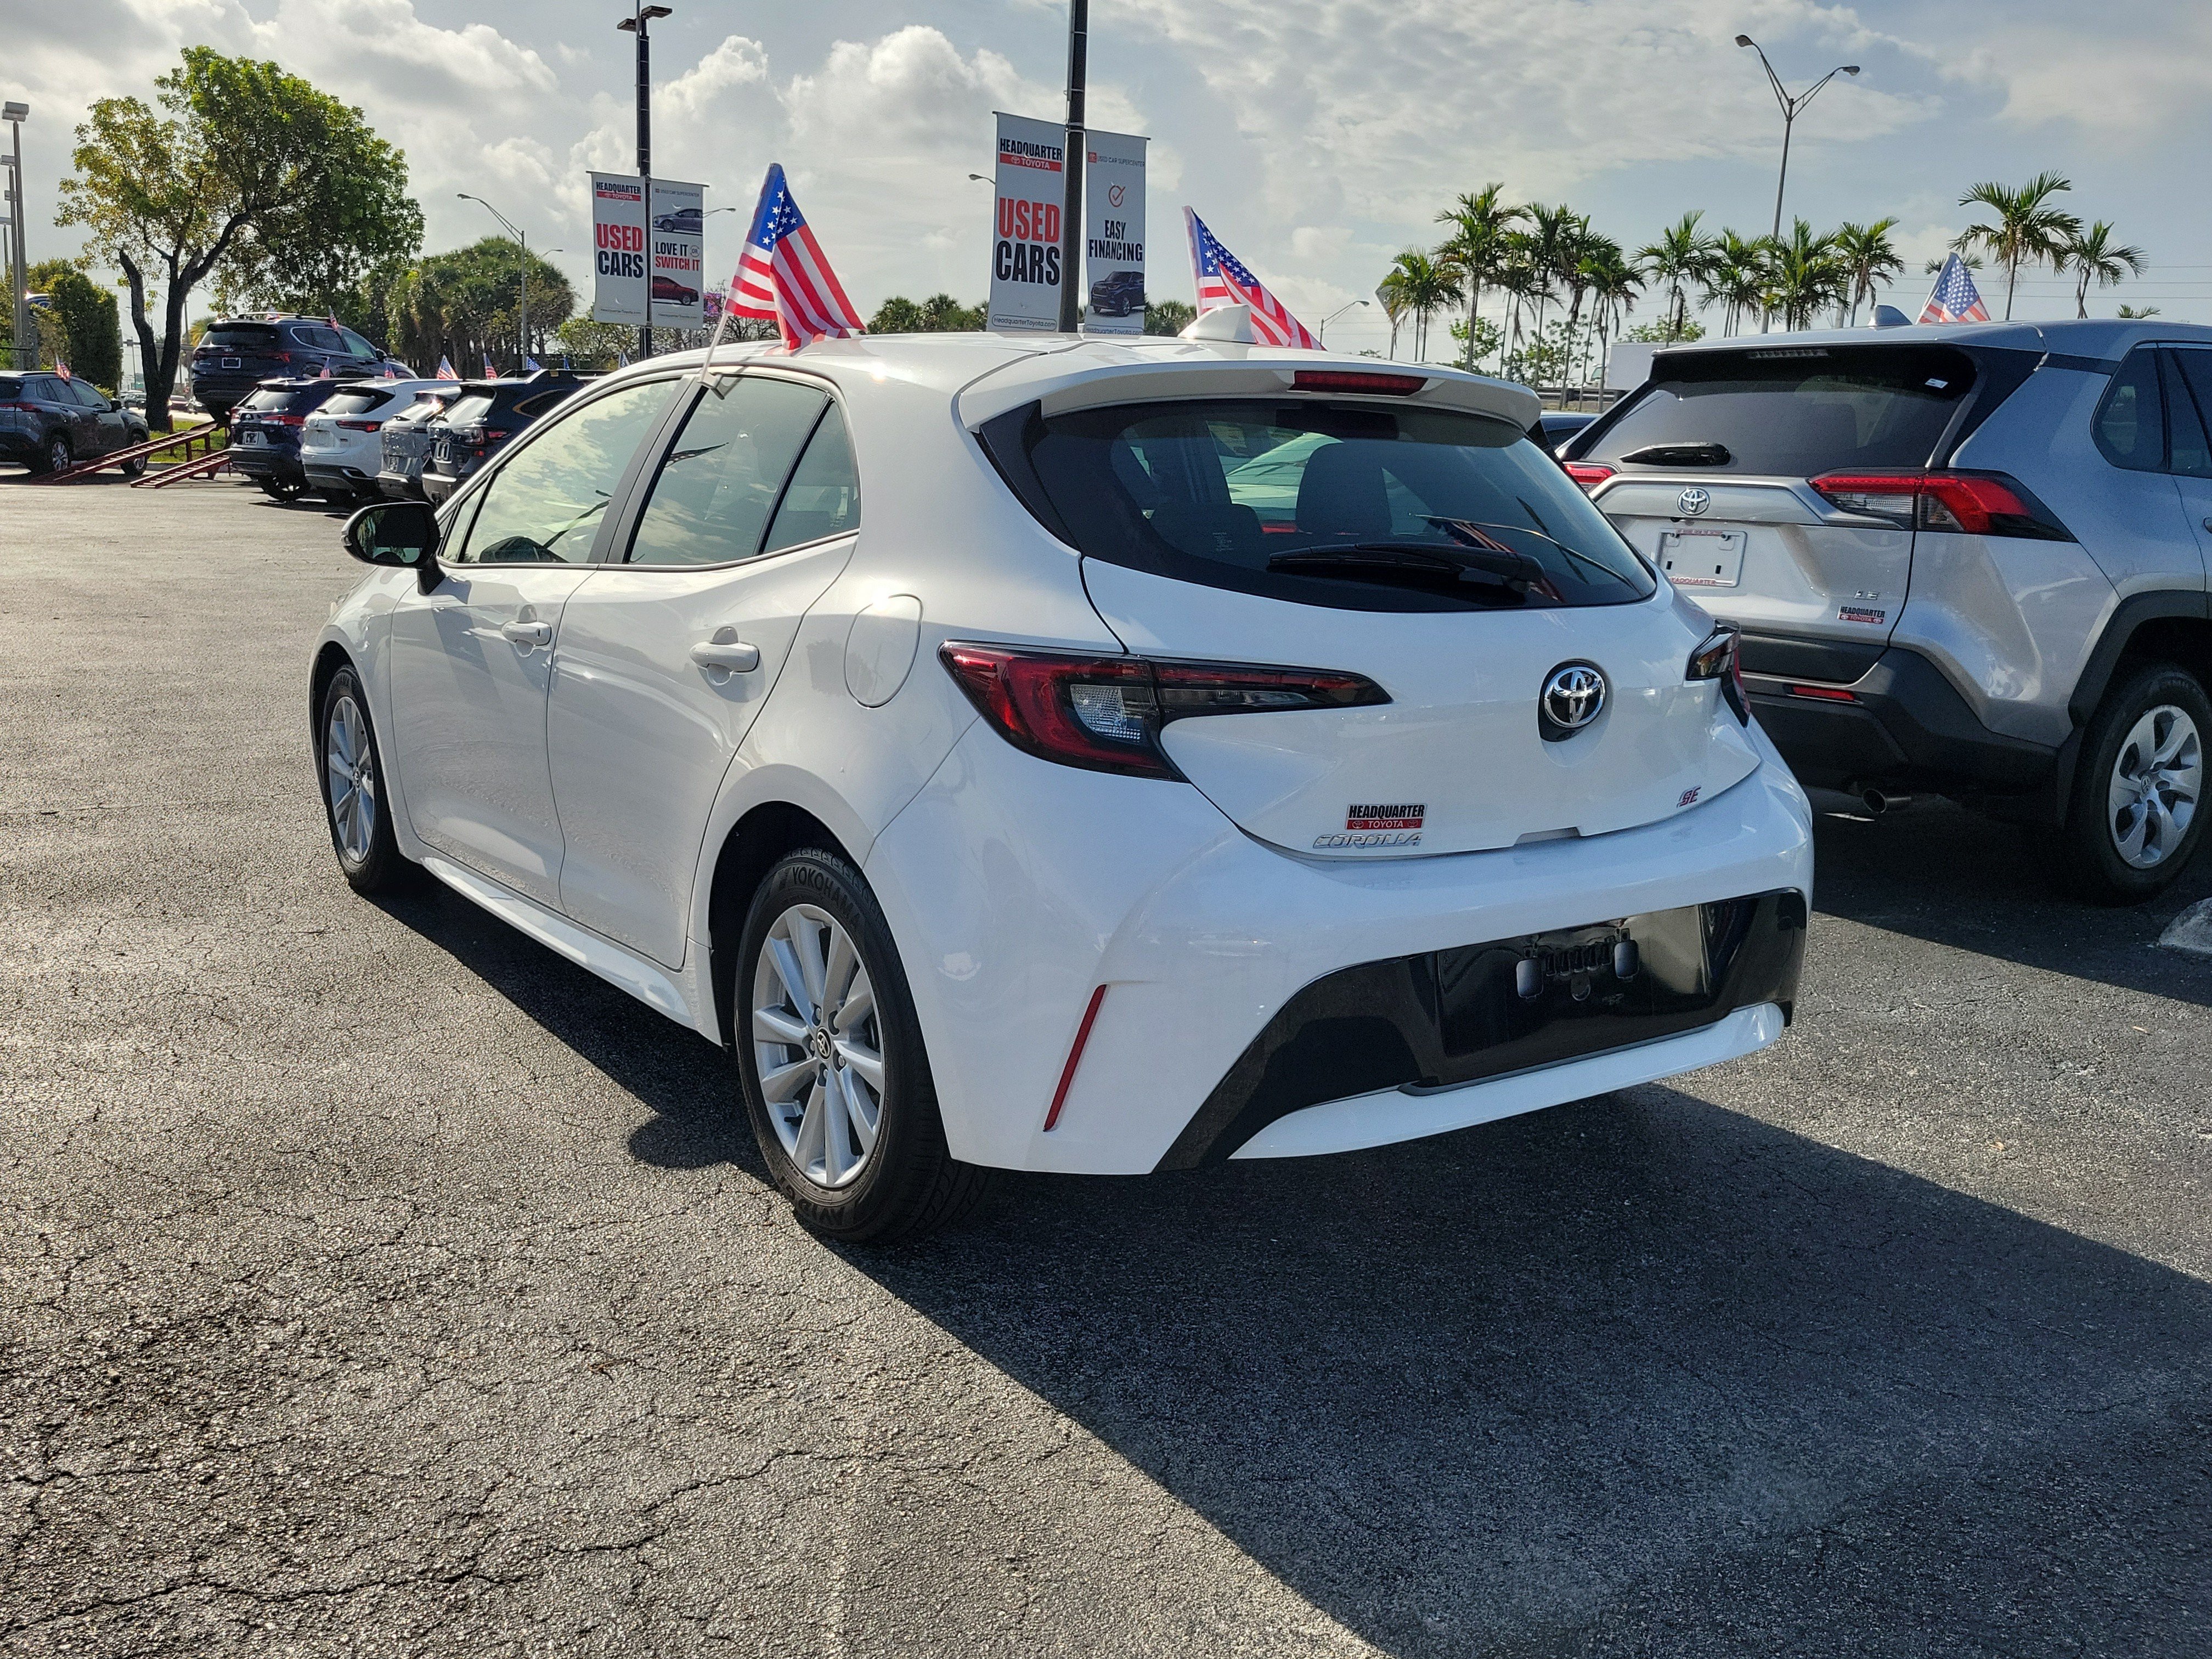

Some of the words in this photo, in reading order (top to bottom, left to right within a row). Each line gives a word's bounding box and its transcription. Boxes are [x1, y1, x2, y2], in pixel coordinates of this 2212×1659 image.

[1000, 138, 1062, 161] HEADQUARTER
[1021, 157, 1050, 170] TOYOTA
[596, 182, 641, 194] HEADQUARTER
[998, 198, 1060, 242] USED
[1105, 219, 1126, 240] EASY
[596, 223, 643, 252] USED
[656, 242, 677, 255] LOVE
[680, 244, 687, 257] IT
[1088, 240, 1143, 262] FINANCING
[598, 251, 644, 278] CARS
[656, 256, 690, 270] SWITCH
[692, 259, 700, 271] IT
[996, 240, 1060, 286] CARS
[994, 318, 1056, 328] HeadquarterToyota.com
[1841, 606, 1885, 618] HEADQUARTER
[1348, 805, 1425, 819] HEADQUARTER
[1313, 832, 1423, 849] COROLLA
[793, 867, 859, 928] YOKOHAMA
